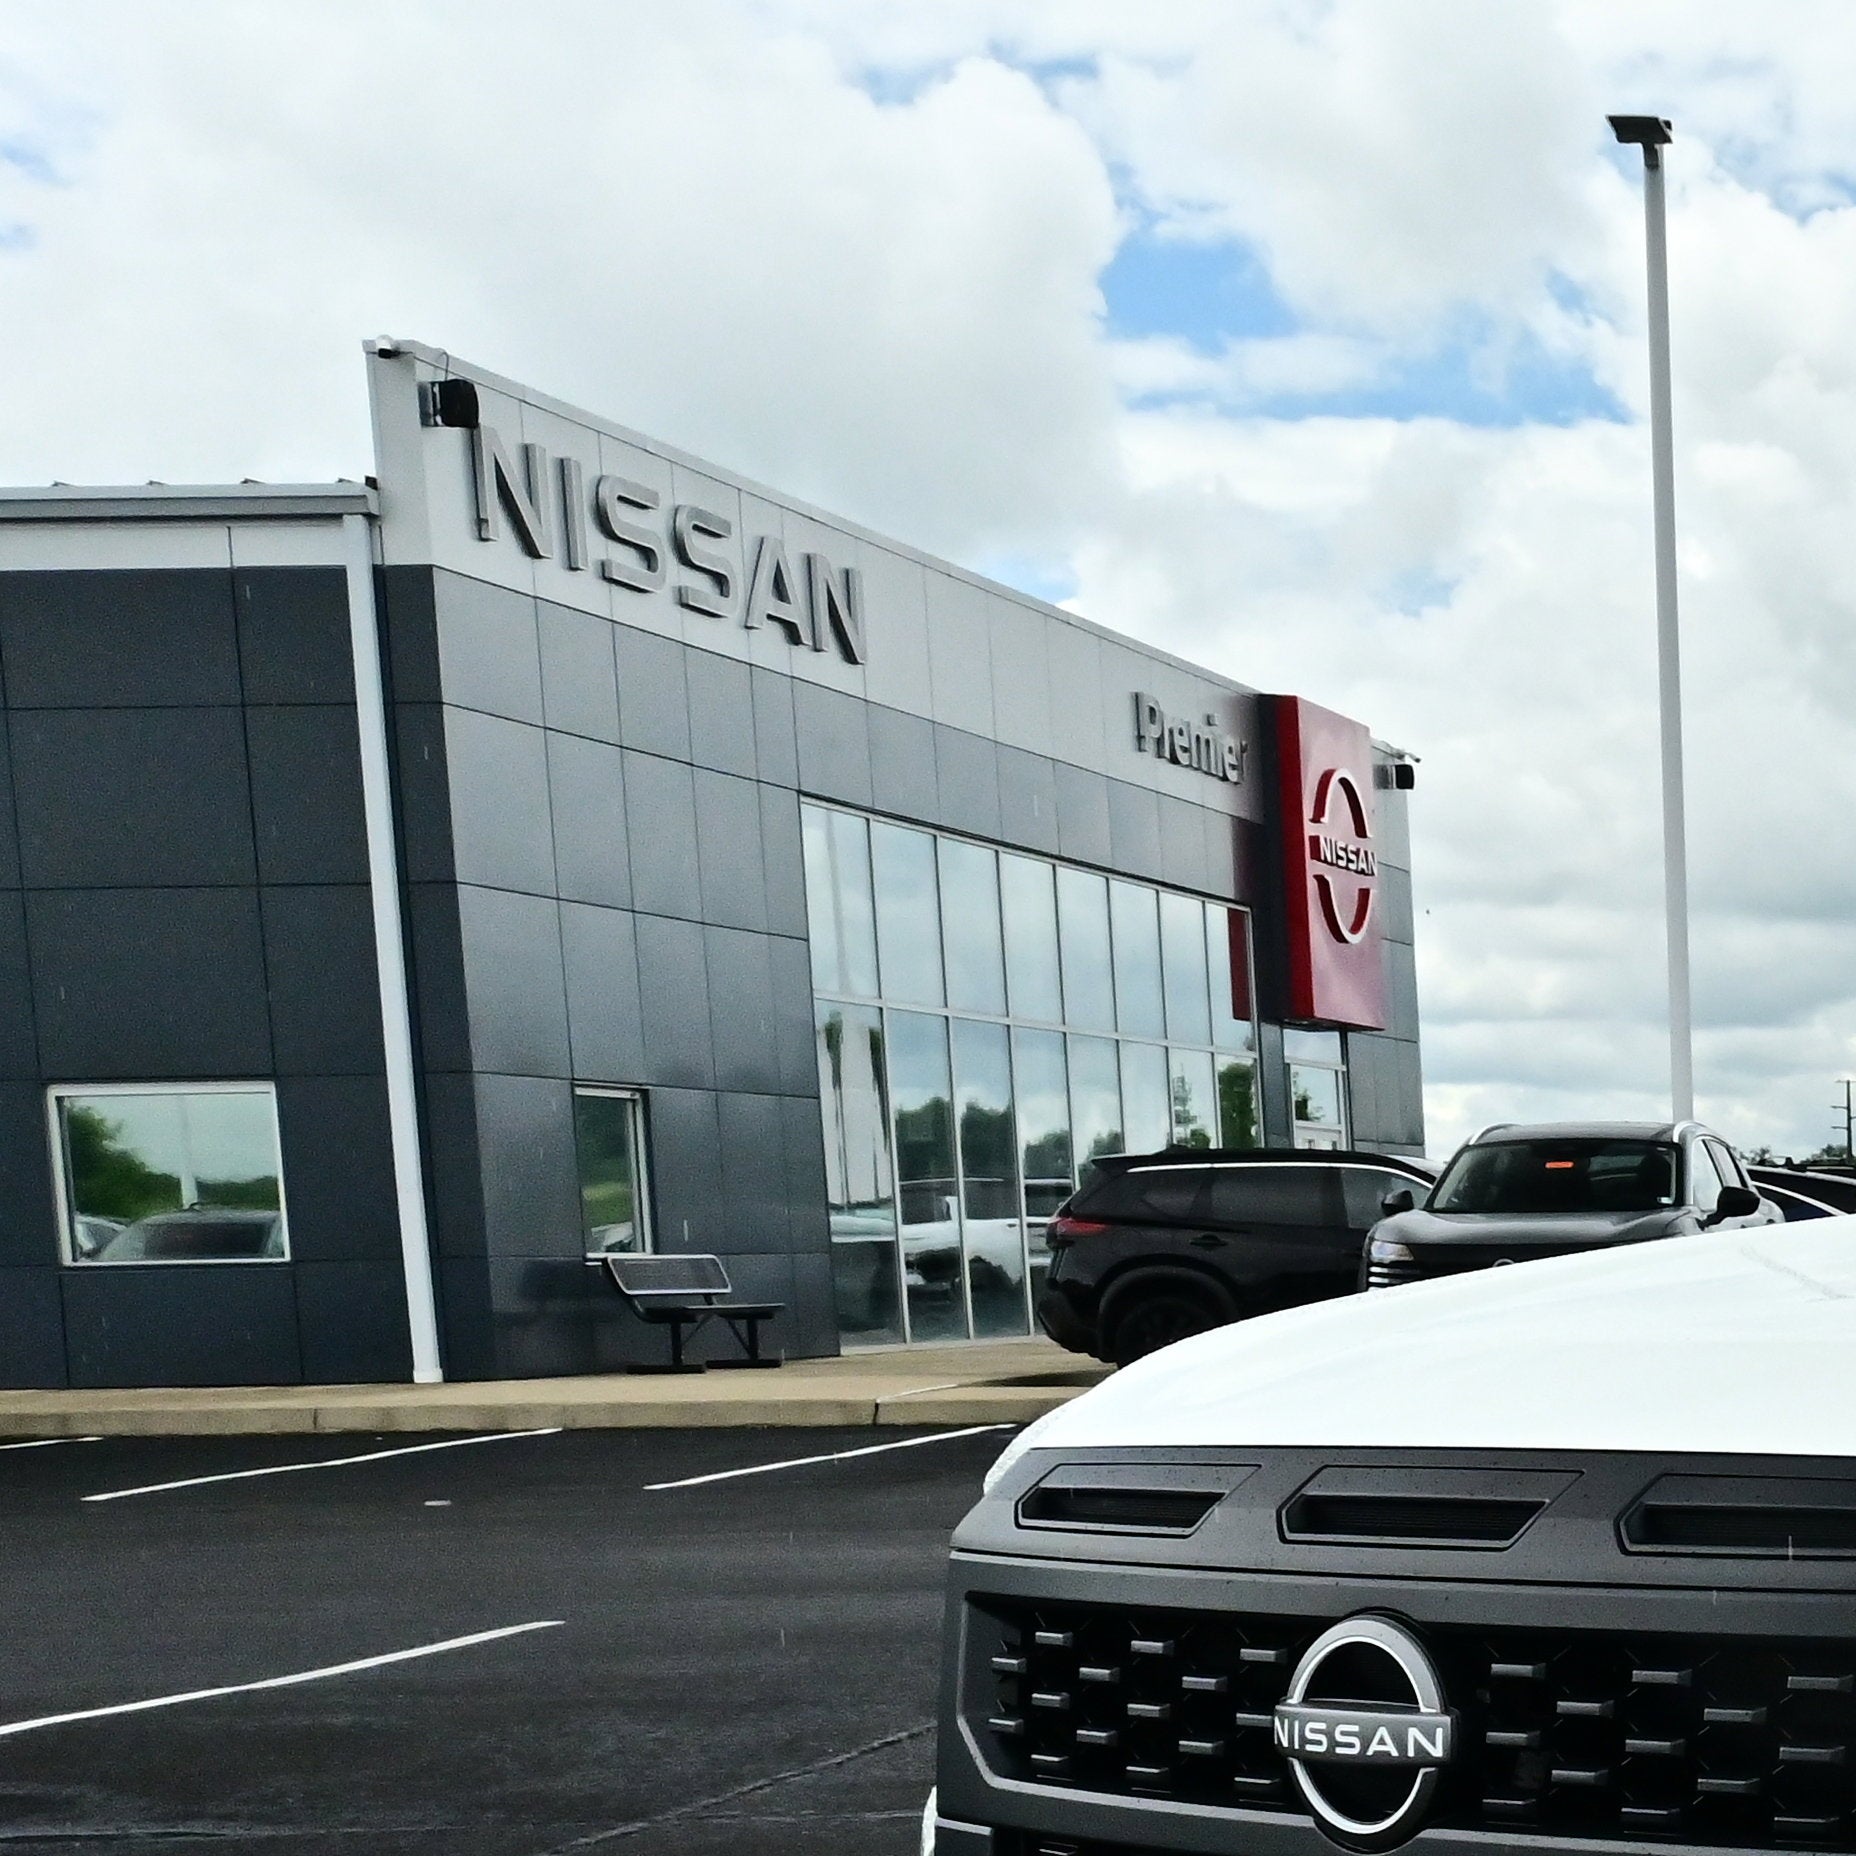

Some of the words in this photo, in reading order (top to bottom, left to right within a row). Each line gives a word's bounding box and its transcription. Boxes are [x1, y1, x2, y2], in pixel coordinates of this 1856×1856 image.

[471, 423, 867, 666] NISSAN
[1131, 692, 1248, 784] Premier
[1318, 835, 1378, 876] NISSAN
[1274, 1715, 1444, 1758] NISSAN
